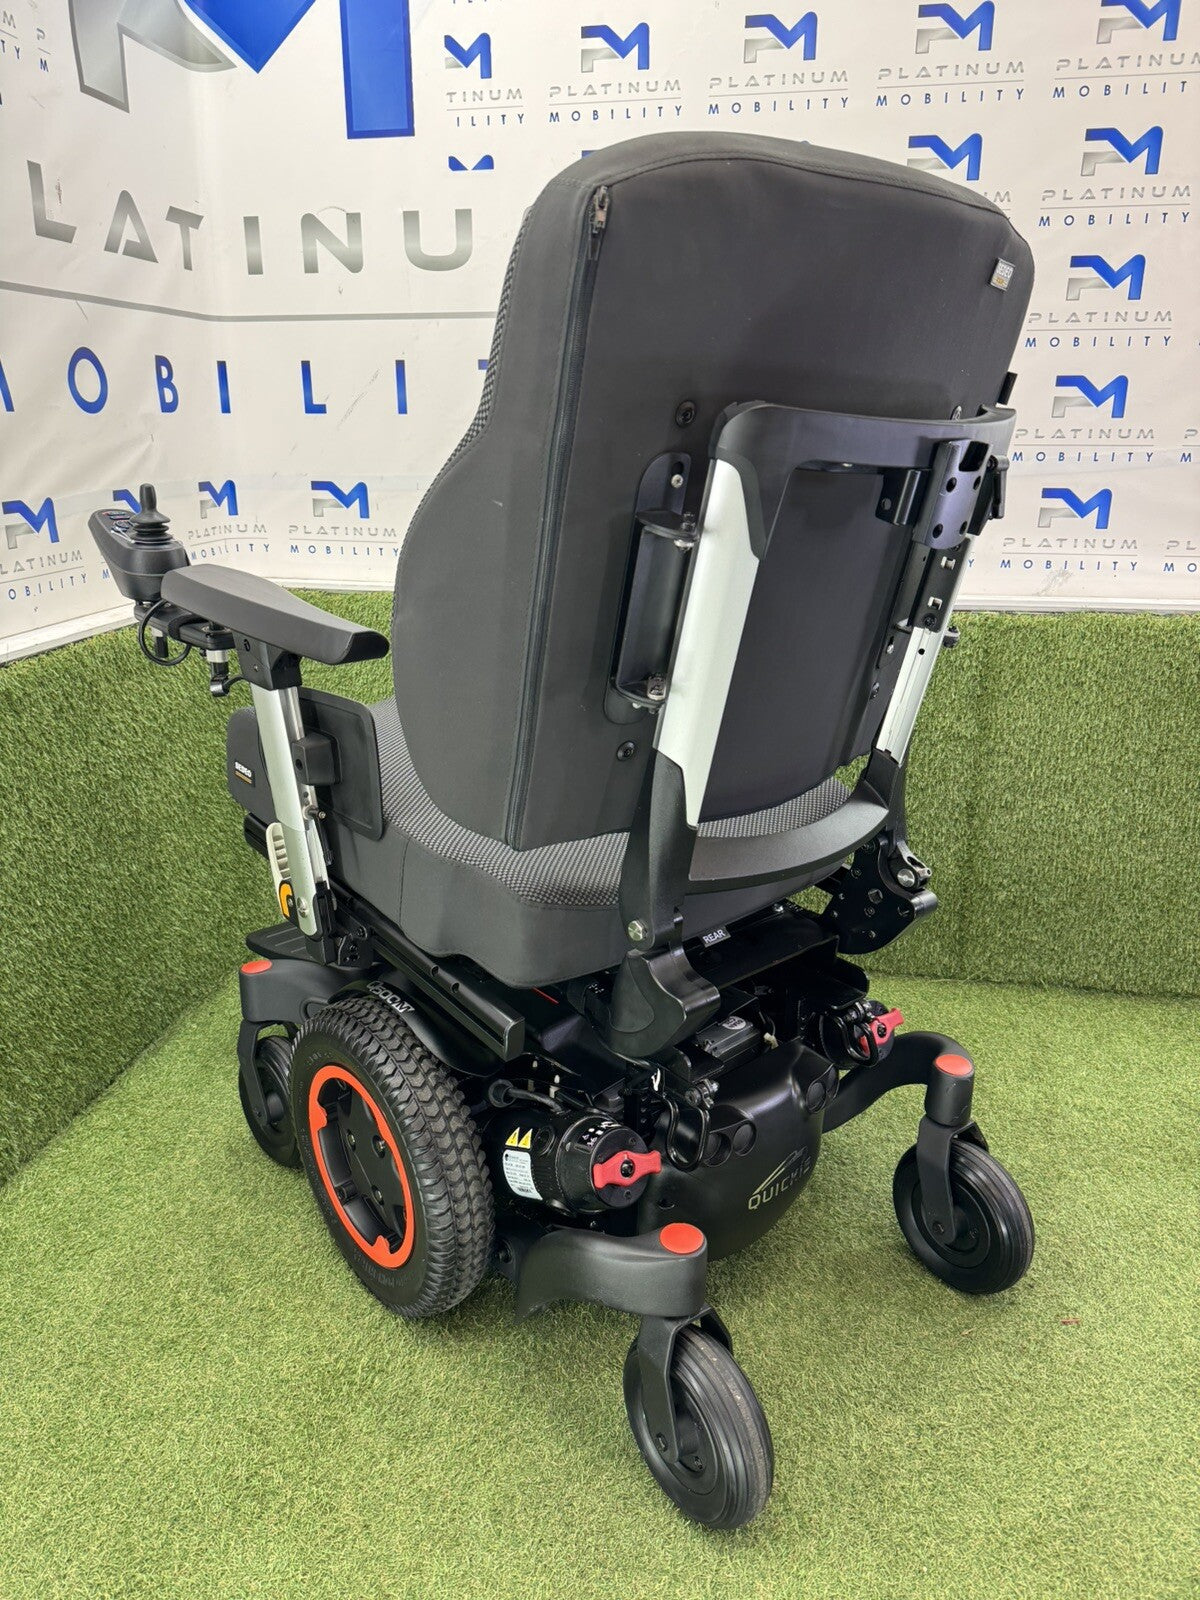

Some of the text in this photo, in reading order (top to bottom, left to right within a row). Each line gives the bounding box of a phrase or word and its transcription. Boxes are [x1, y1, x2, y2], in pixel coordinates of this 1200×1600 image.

[878, 61, 1025, 80] PLATINUM
[709, 70, 848, 89] PLATINUM
[550, 79, 682, 98] PLATINUM
[876, 88, 1024, 106] MOBILITY
[708, 97, 848, 114] MOBILITY
[549, 105, 682, 123] MOBILITY
[1041, 185, 1191, 202] PLATINUM
[1039, 211, 1190, 227] MOBILITY
[1028, 310, 1172, 323] PLATINUM
[1025, 335, 1172, 348] MOBILITY
[0, 346, 489, 415] OBILI
[1015, 428, 1155, 439] PLATINUM
[1011, 451, 1154, 462] MOBILITY
[188, 524, 267, 540] PLATINUM
[288, 525, 397, 537] PLATINUM
[290, 545, 398, 556] MOBILITY
[1003, 537, 1138, 549] PLATINUM
[191, 543, 270, 560] MOBILITY
[1000, 559, 1138, 571] MOBILITY
[702, 929, 726, 944] REAR
